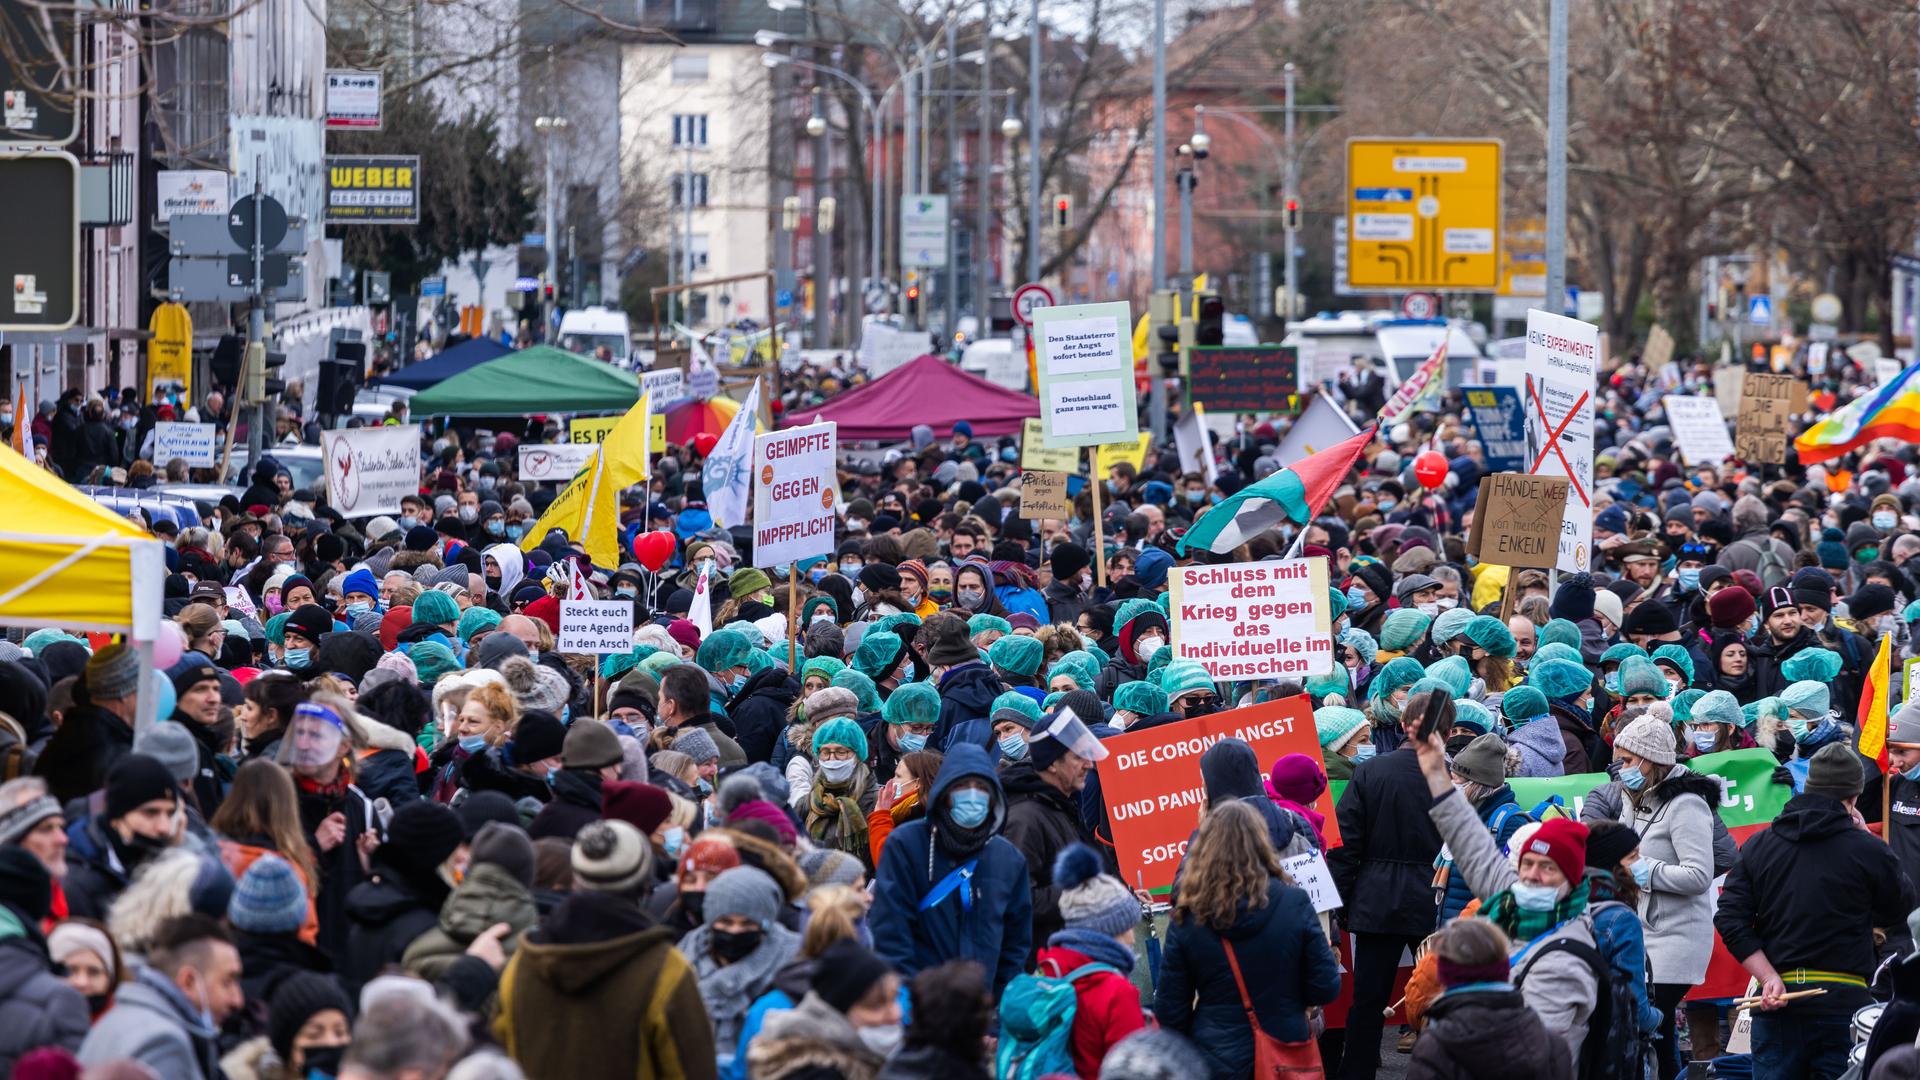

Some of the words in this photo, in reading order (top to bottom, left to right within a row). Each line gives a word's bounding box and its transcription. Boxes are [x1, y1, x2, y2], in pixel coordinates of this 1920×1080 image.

[331, 167, 412, 188] WEBER
[1065, 331, 1116, 342] Staatsterror
[1078, 341, 1102, 351] Angst
[1529, 330, 1546, 347] KEINE
[1547, 334, 1594, 359] EXPERIMENTE
[1053, 353, 1076, 361] sofort
[1078, 349, 1113, 359] beenden!
[1055, 406, 1074, 414] ganz
[1091, 402, 1119, 411] wagen.
[1061, 393, 1111, 404] Deutschland
[574, 430, 592, 444] ES
[766, 432, 830, 460] GEIMPFTE
[772, 476, 819, 502] GEGEN
[1493, 475, 1541, 499] HÄNDE
[1543, 484, 1566, 500] WEG
[758, 515, 835, 547] IMPFPFLICHT
[1492, 520, 1509, 530] von
[1498, 534, 1546, 555] ENKELN
[1184, 567, 1267, 586] Schluss
[1273, 563, 1308, 580] mit
[1231, 583, 1276, 599] dem
[565, 607, 599, 617] Steckt
[602, 607, 628, 617] euch
[1181, 604, 1237, 622] Krieg
[1248, 601, 1313, 621] gegen
[563, 624, 587, 632] eure
[589, 623, 630, 635] Agenda
[1233, 621, 1271, 637] das
[563, 638, 573, 648] in
[576, 638, 597, 648] den
[599, 638, 629, 648] Arsch
[1180, 638, 1302, 659] Individuelle
[1305, 636, 1331, 651] im
[1202, 657, 1309, 677] Menschen
[1116, 750, 1149, 771] DIE
[1151, 732, 1226, 762] CORONA
[1235, 717, 1295, 742] ANGST
[1112, 798, 1155, 821] UND
[1141, 841, 1190, 865] SOFO
